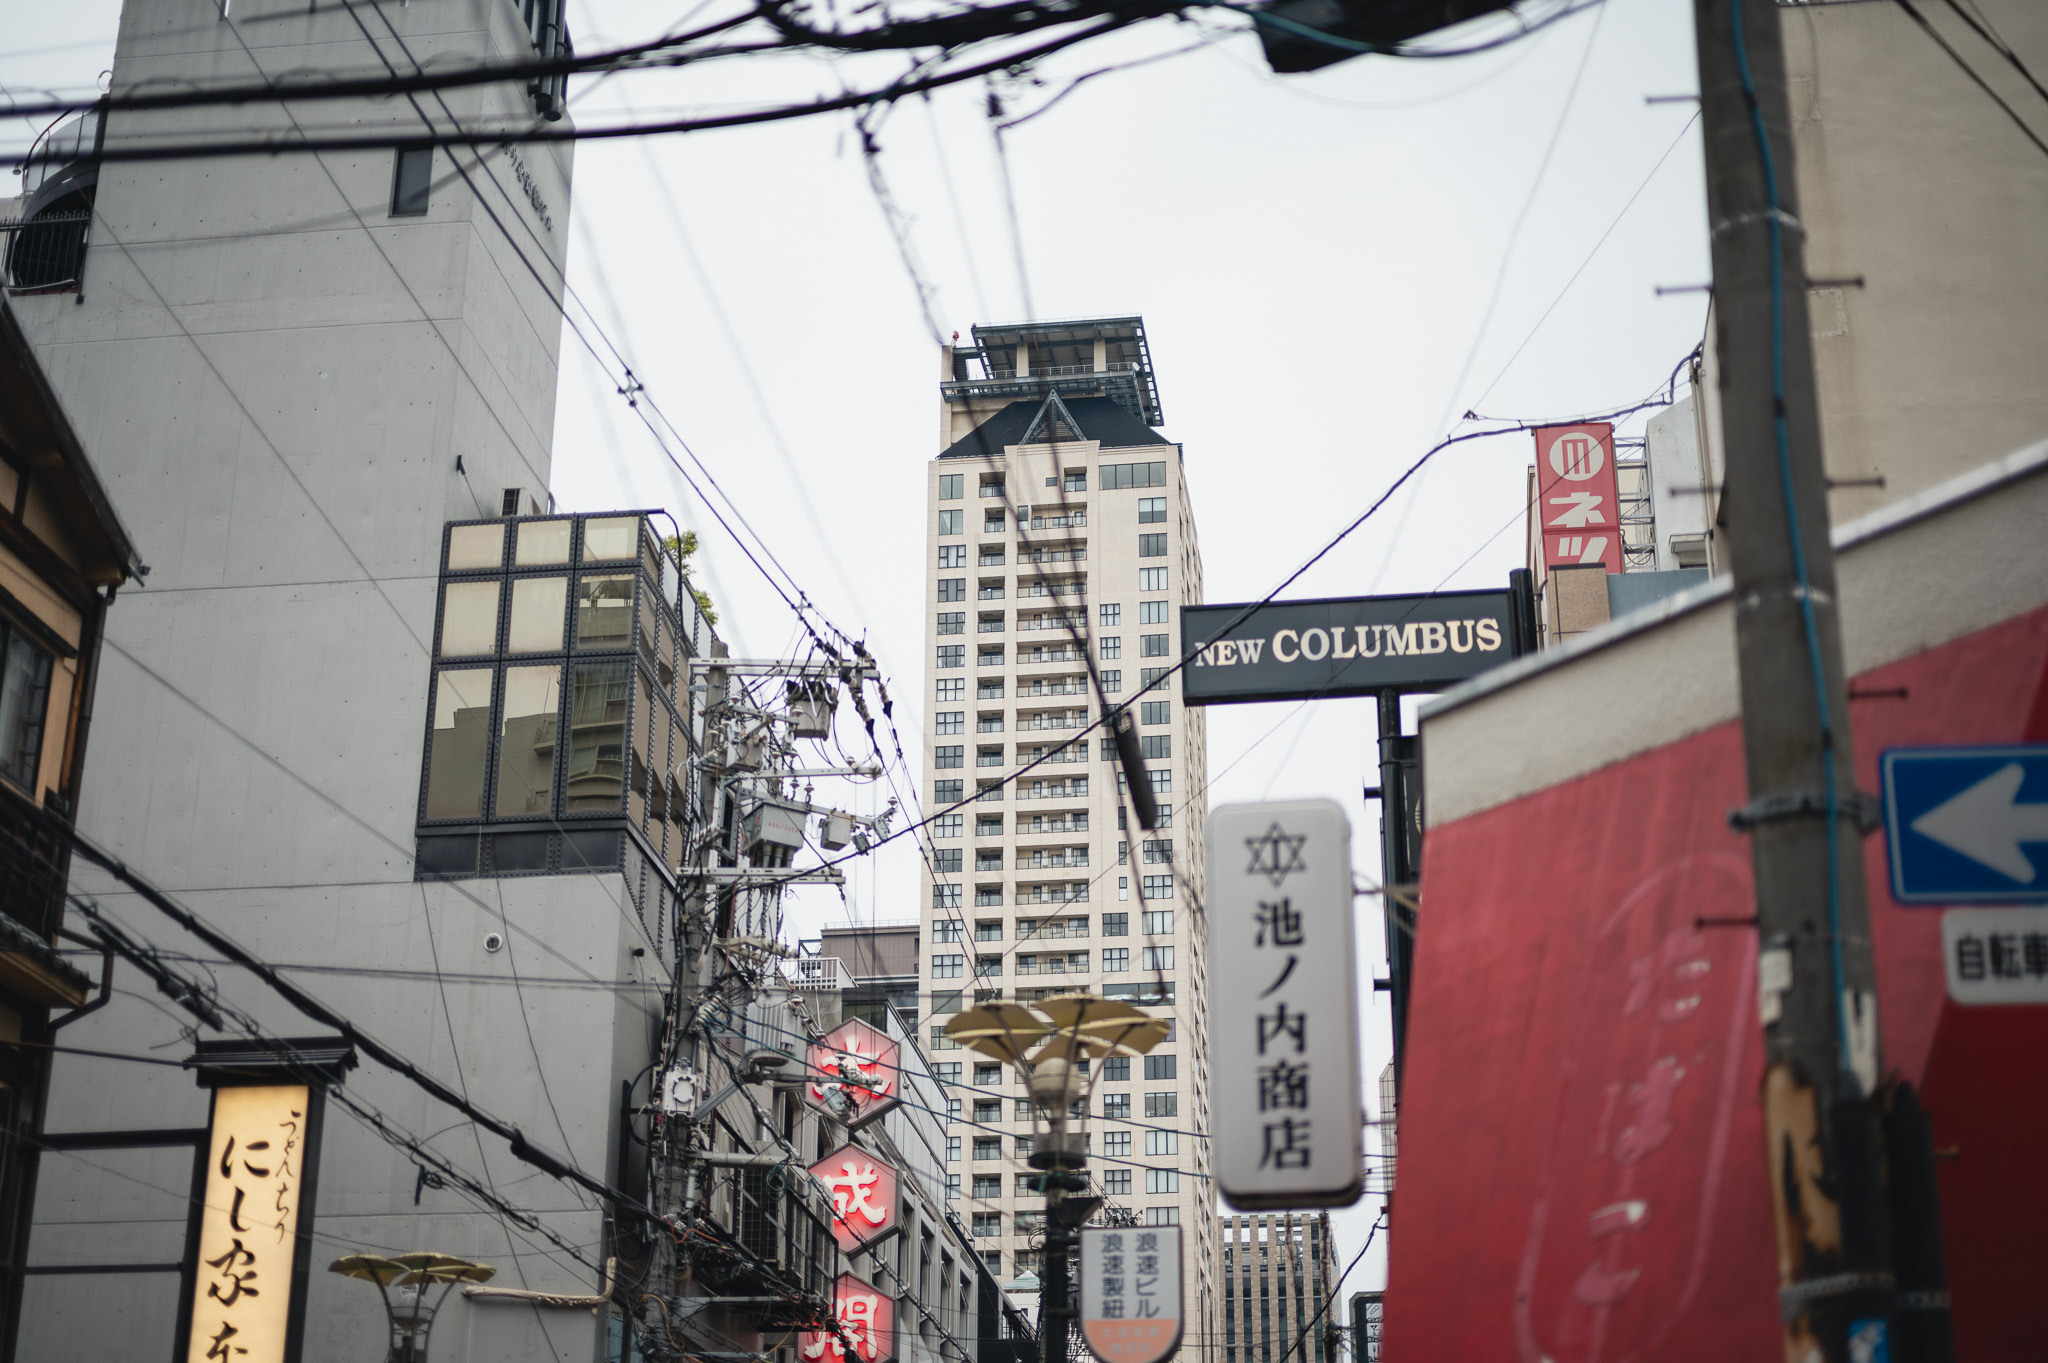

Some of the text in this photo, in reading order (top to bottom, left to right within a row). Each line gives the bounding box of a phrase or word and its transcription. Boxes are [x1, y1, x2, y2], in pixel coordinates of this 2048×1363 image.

[1194, 617, 1502, 668] NEW COLUMBUS
[1252, 896, 1313, 1173] 池ノ内商店
[1135, 1232, 1160, 1319] 浪速ビル
